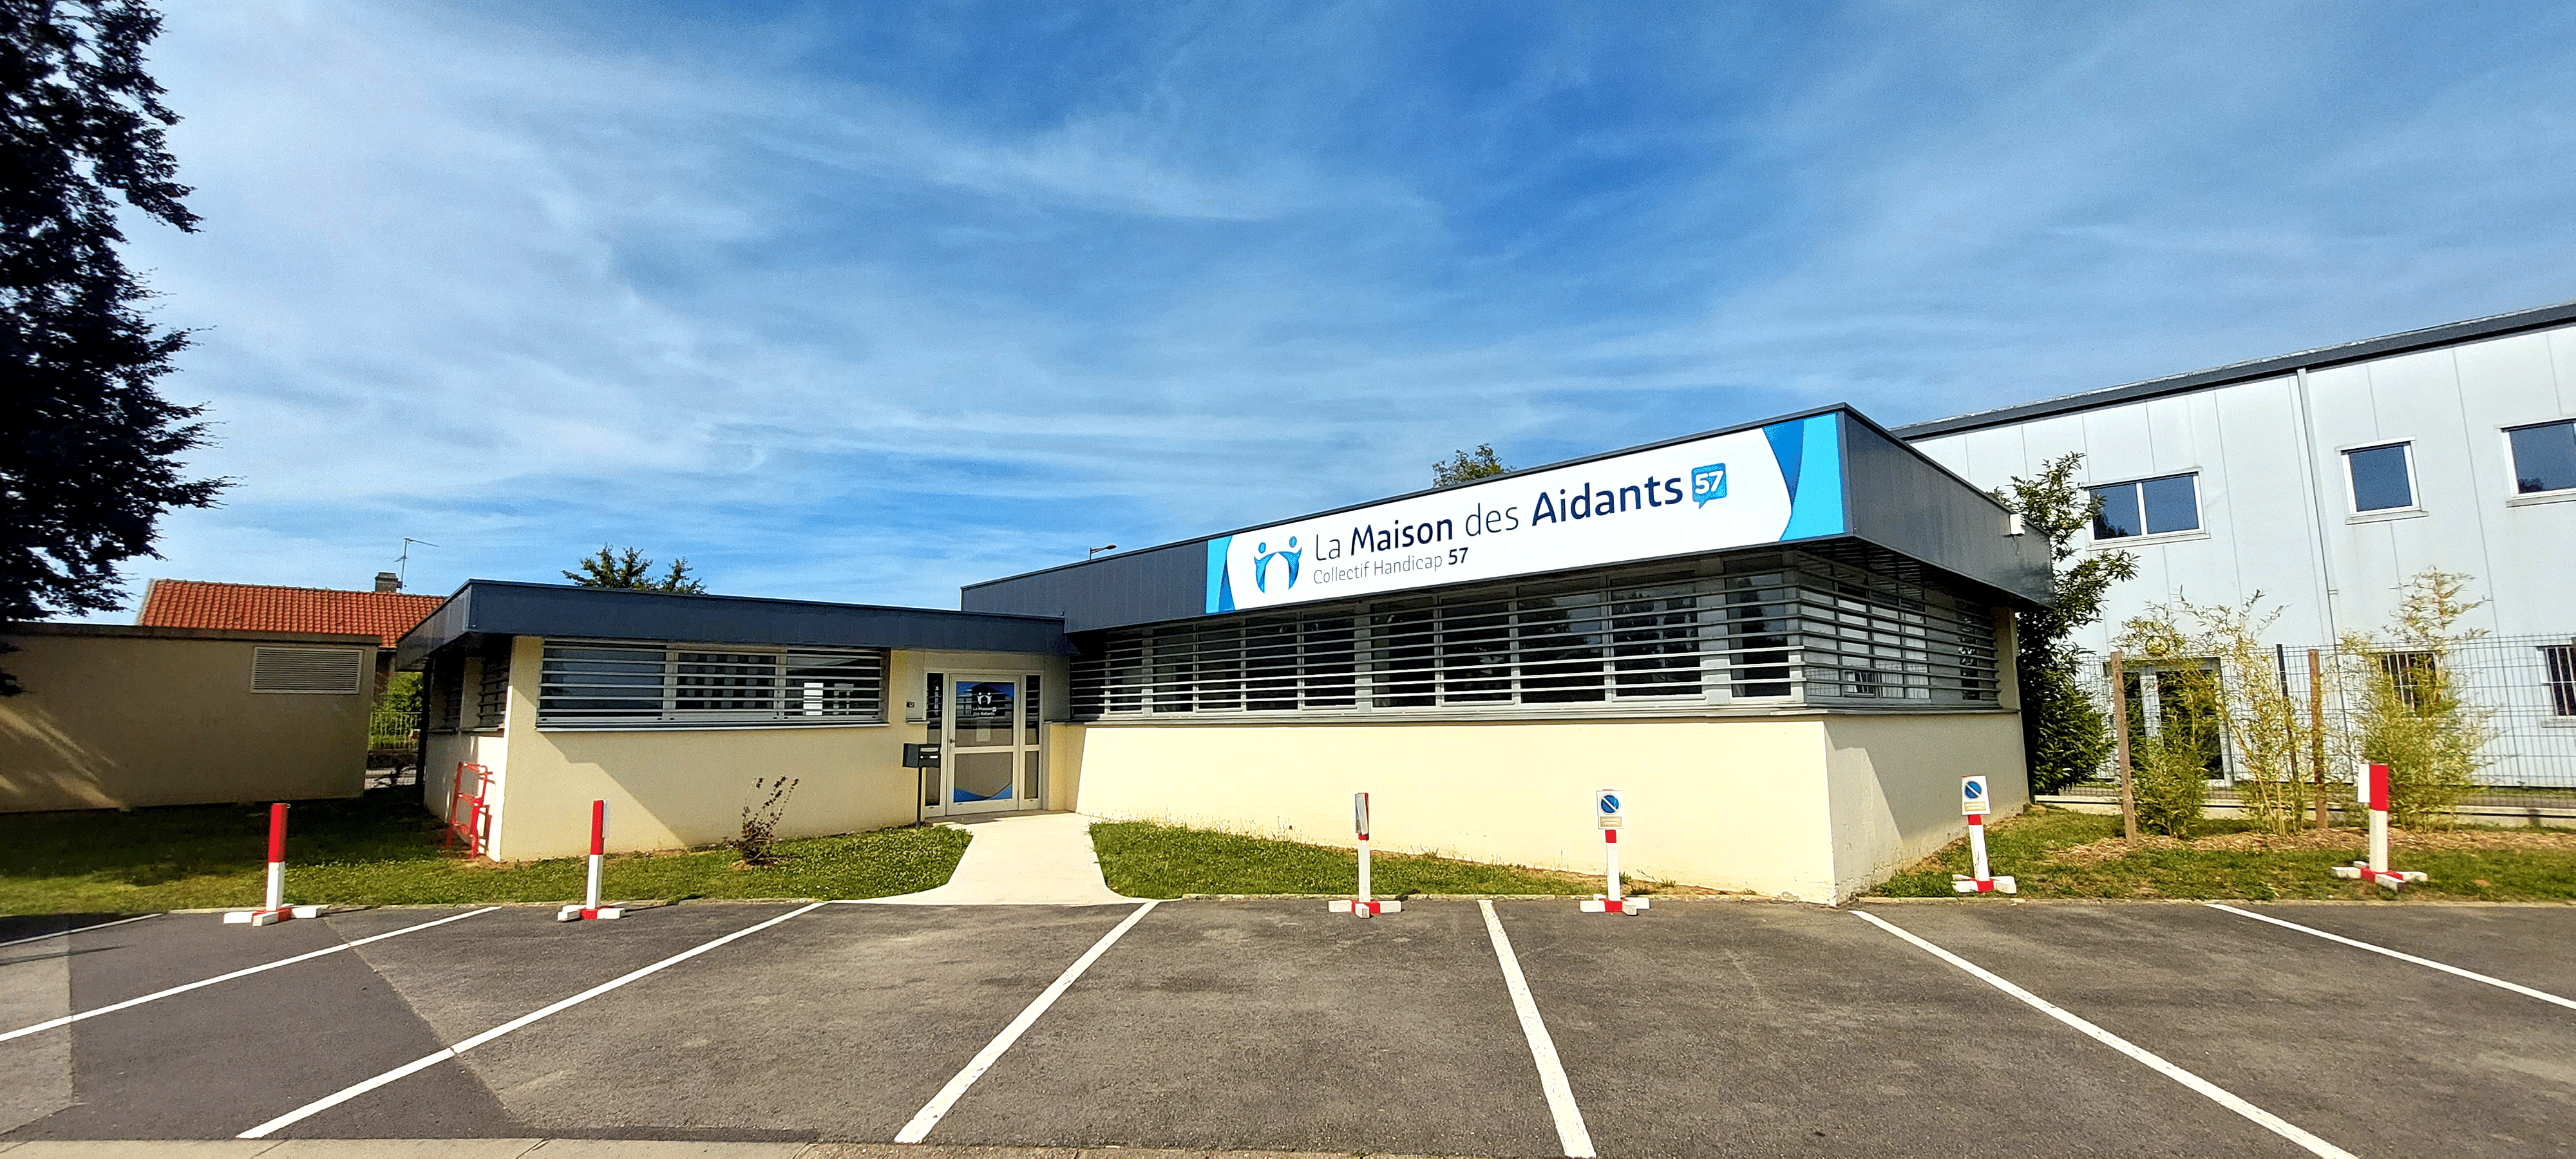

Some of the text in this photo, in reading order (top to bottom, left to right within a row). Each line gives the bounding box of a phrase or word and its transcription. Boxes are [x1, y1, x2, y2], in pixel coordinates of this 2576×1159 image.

[1316, 470, 1724, 561] La Maison des Aidants 57
[1314, 547, 1469, 583] Collectif Handicap 57
